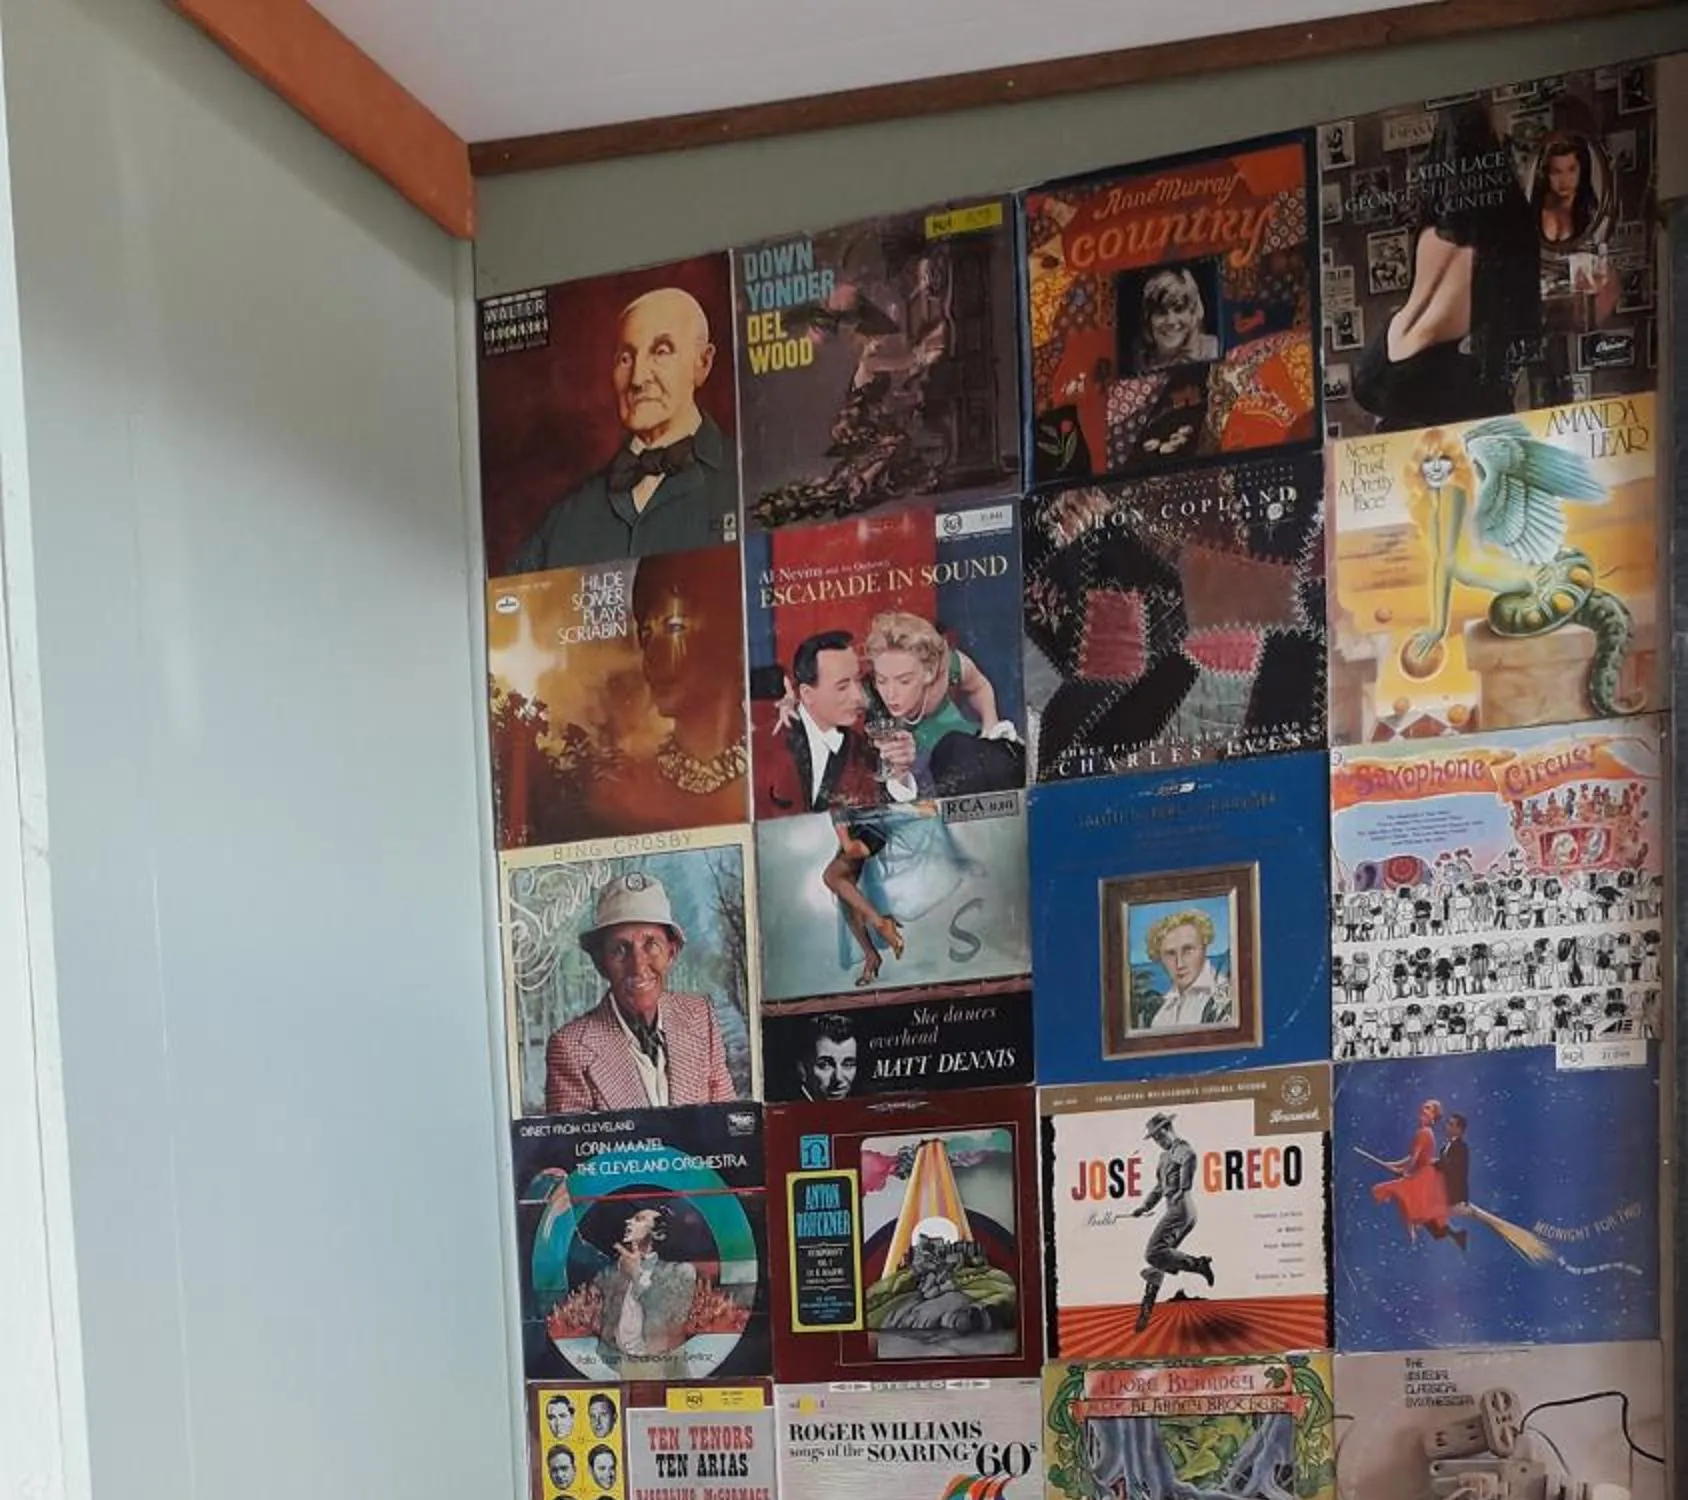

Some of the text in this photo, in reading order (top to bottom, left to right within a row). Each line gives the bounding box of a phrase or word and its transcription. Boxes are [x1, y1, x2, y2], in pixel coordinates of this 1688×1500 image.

[1406, 151, 1505, 183] LATIN LACE
[743, 240, 814, 281] DOWN
[746, 269, 835, 311] YONDER
[483, 299, 545, 323] WALTER
[747, 312, 787, 344] DEL
[749, 340, 814, 375] WOOD
[1546, 401, 1639, 436] AMANDA
[1590, 427, 1649, 459] LEAR
[1161, 486, 1297, 520] COPLAND
[581, 570, 625, 593] HILDE
[761, 554, 1008, 609] ESCAPADE IN SOUND
[583, 603, 626, 626] PLAYS
[558, 621, 627, 645] SCRIABIN
[1059, 734, 1301, 777] CHARLES IVES
[1354, 759, 1485, 797] Saxophone
[947, 797, 984, 815] RCA
[553, 831, 693, 860] BING CROSBY
[912, 1007, 939, 1027] She
[872, 1046, 1017, 1079] MATT DENNIS
[582, 1119, 635, 1133] CLEVELAND
[575, 1137, 666, 1157] LORIN MAAZEL
[576, 1153, 749, 1176] THE CLEVELAND ORCHESTRA
[1071, 1145, 1303, 1201] JOSÉ GRECO
[1534, 1220, 1590, 1241] MIDNIGHT
[1593, 1215, 1617, 1236] FOR
[1405, 1357, 1424, 1369] THE
[648, 1425, 753, 1451] TEN TENORS
[789, 1419, 983, 1441] ROGER WILLIAMS
[656, 1453, 749, 1477] TEN ARIAS
[789, 1446, 825, 1463] songs
[826, 1443, 842, 1457] of
[843, 1443, 864, 1457] the
[867, 1442, 970, 1463] SOARING
